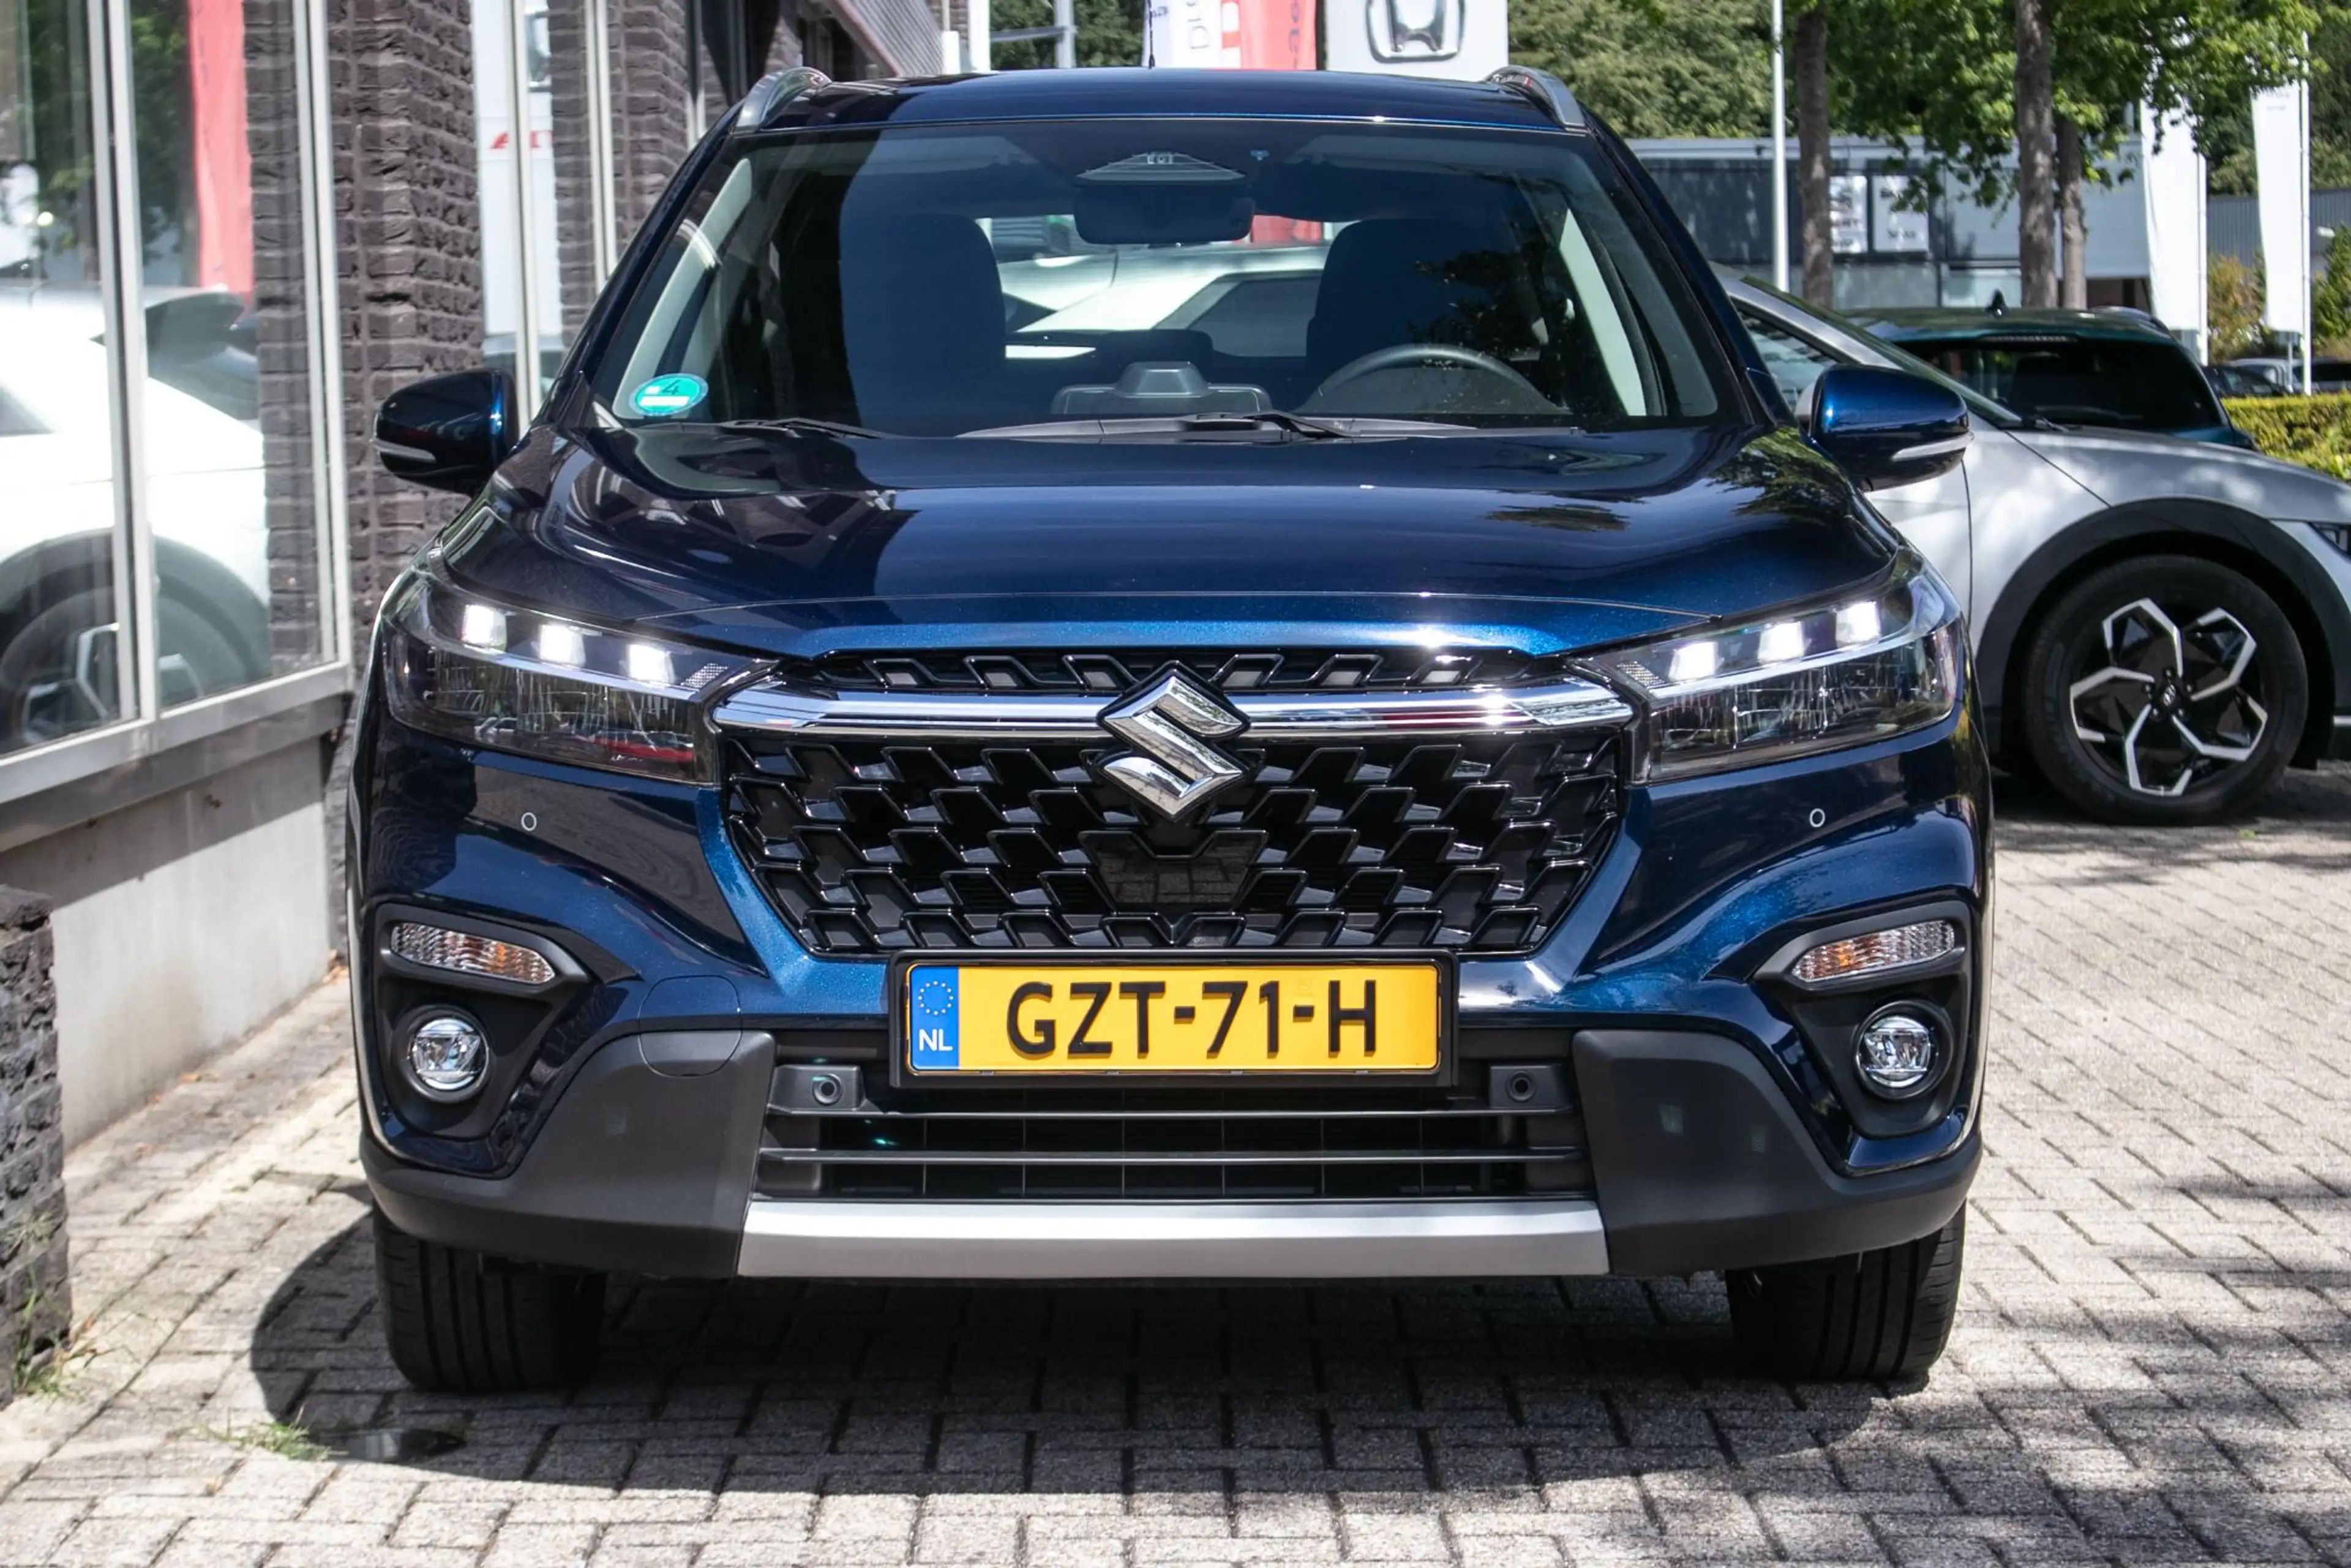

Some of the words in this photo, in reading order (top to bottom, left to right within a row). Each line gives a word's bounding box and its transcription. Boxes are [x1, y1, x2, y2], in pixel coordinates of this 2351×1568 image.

[661, 379, 680, 395] 4
[1007, 980, 1377, 1059] GZT-71-H
[919, 1029, 953, 1052] NL
